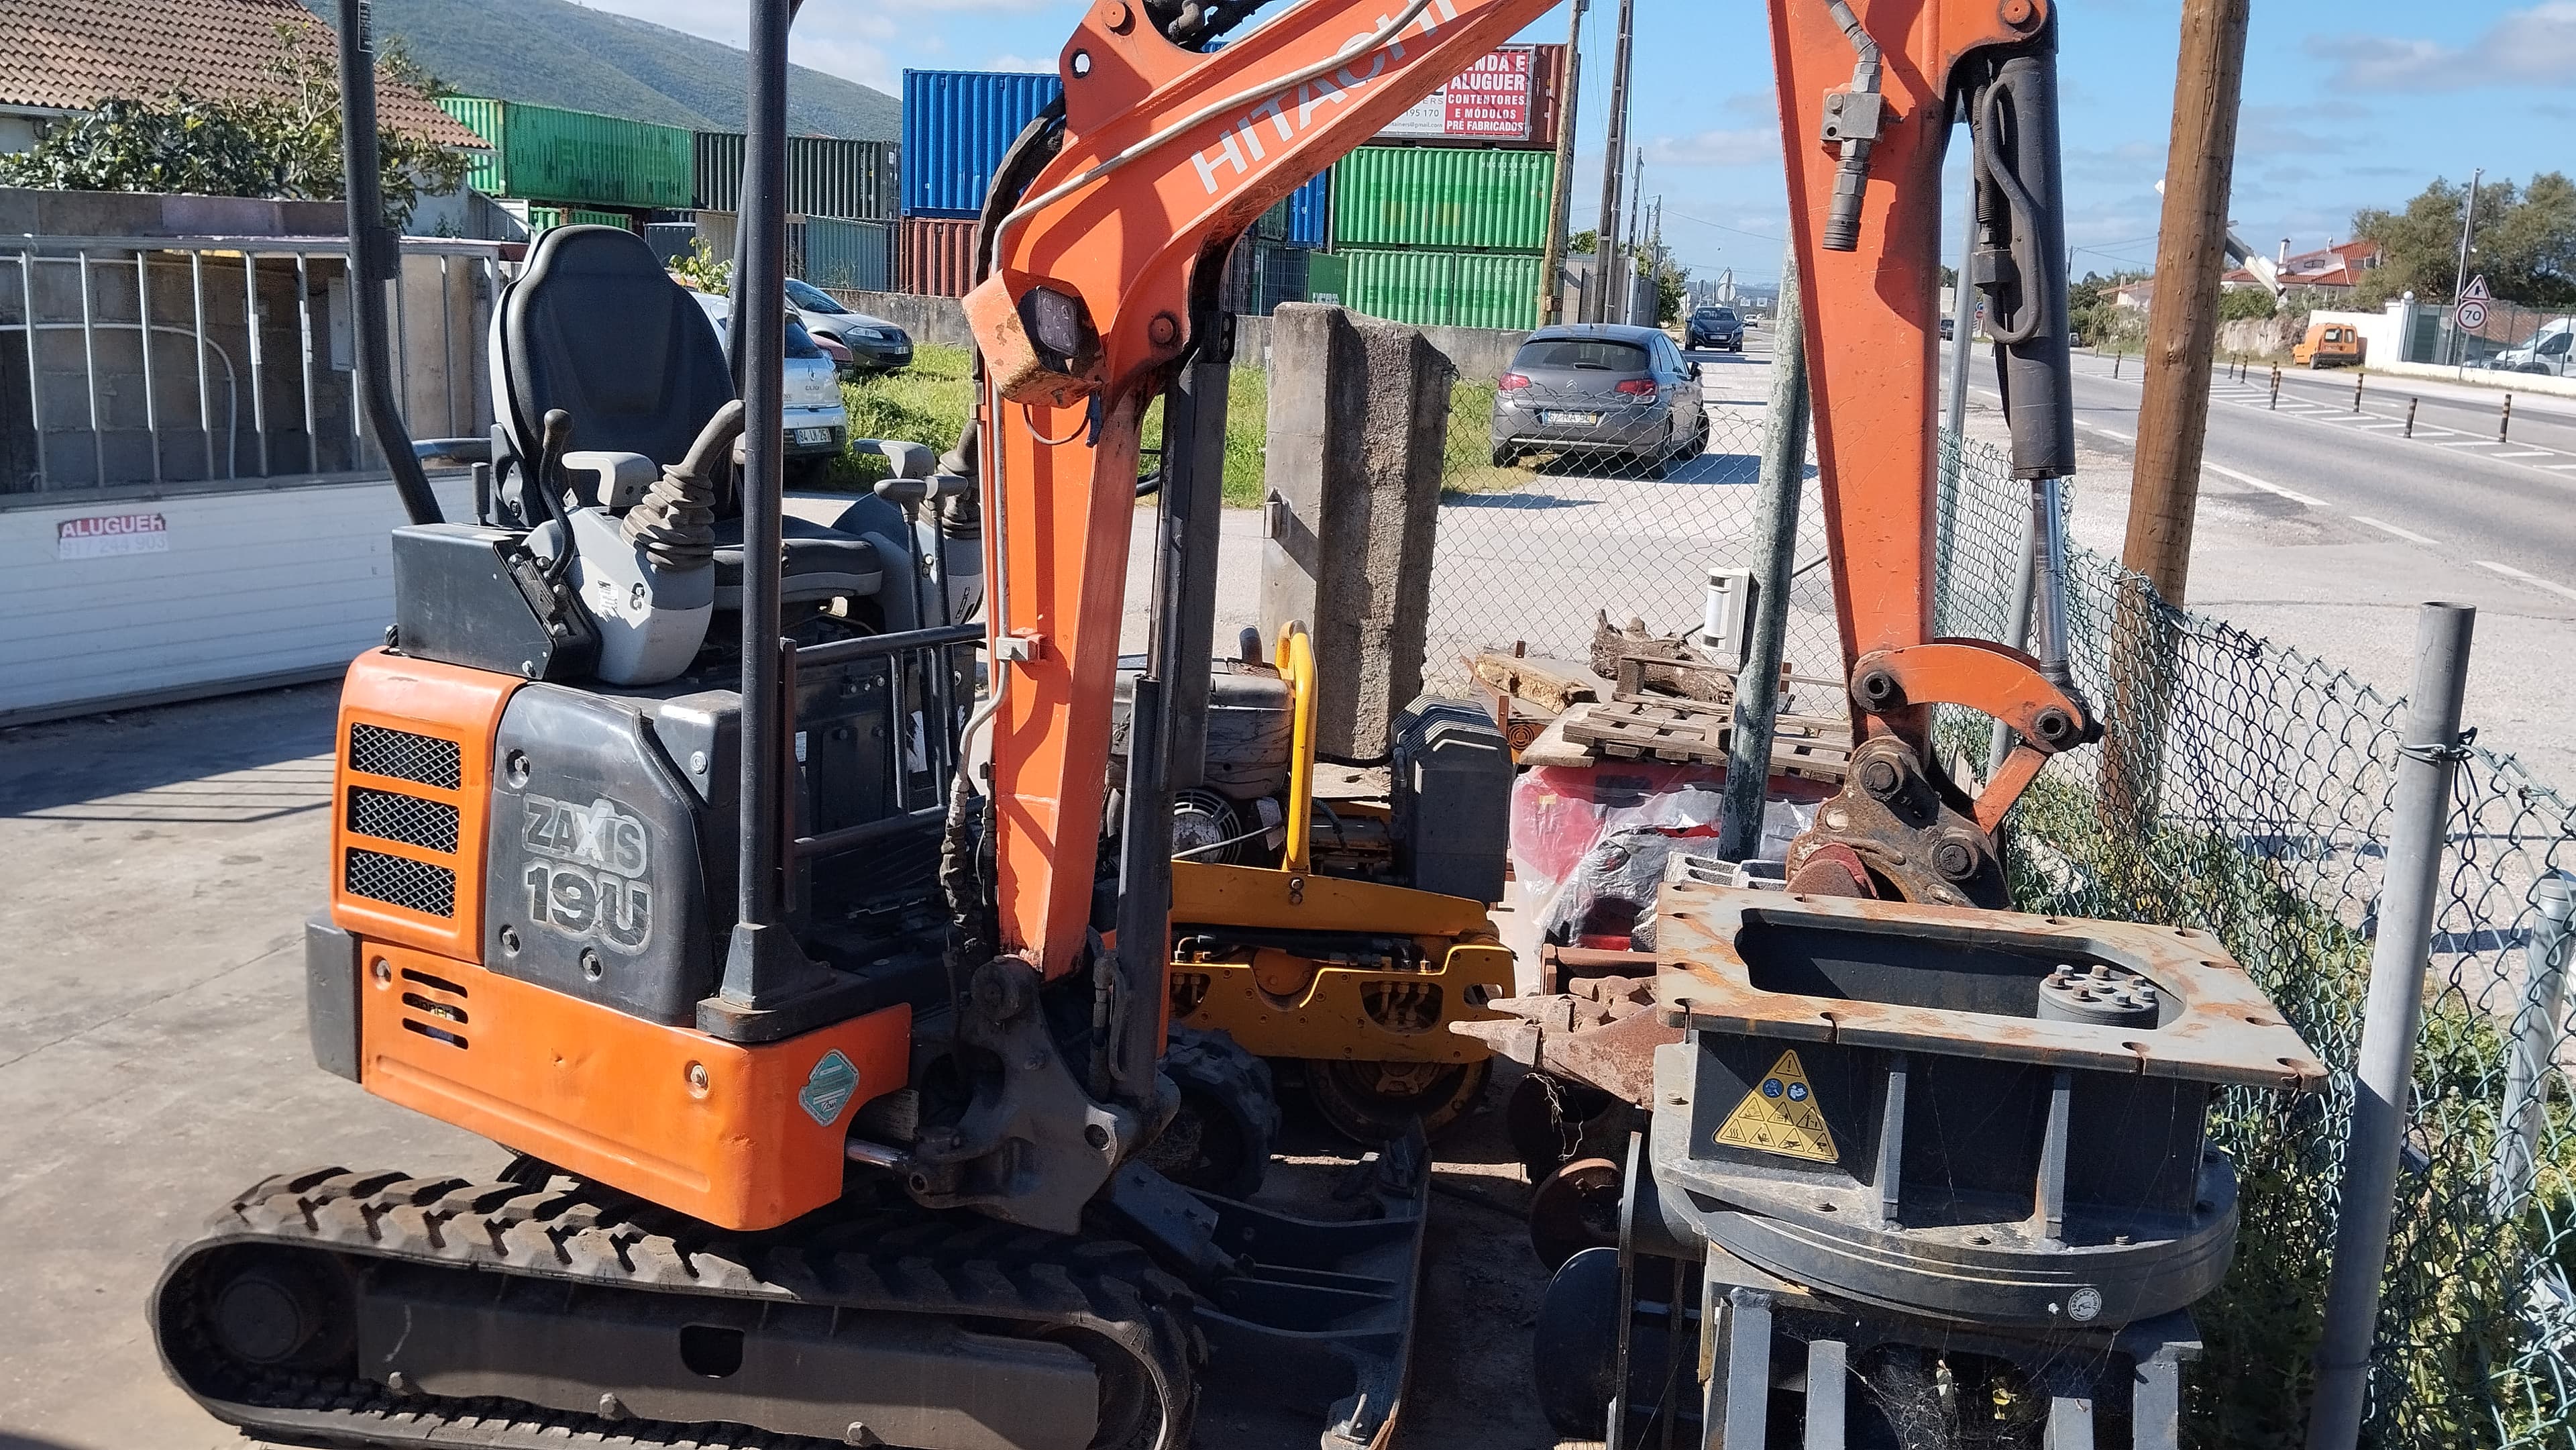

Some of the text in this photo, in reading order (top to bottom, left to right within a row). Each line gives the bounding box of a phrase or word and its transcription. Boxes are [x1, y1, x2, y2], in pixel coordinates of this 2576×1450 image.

[1464, 54, 1525, 72] NDA E
[1450, 72, 1525, 91] ALUGUER
[1448, 94, 1525, 105] CONTENTORES
[1424, 109, 1440, 117] 170
[1455, 106, 1516, 119] E MÓDULOS
[1446, 118, 1523, 132] PRÉ FABRICADOS
[2465, 310, 2481, 321] 70
[61, 515, 163, 537] ALUGUER
[525, 798, 645, 875] ZAXIS
[525, 864, 650, 948] 19U
